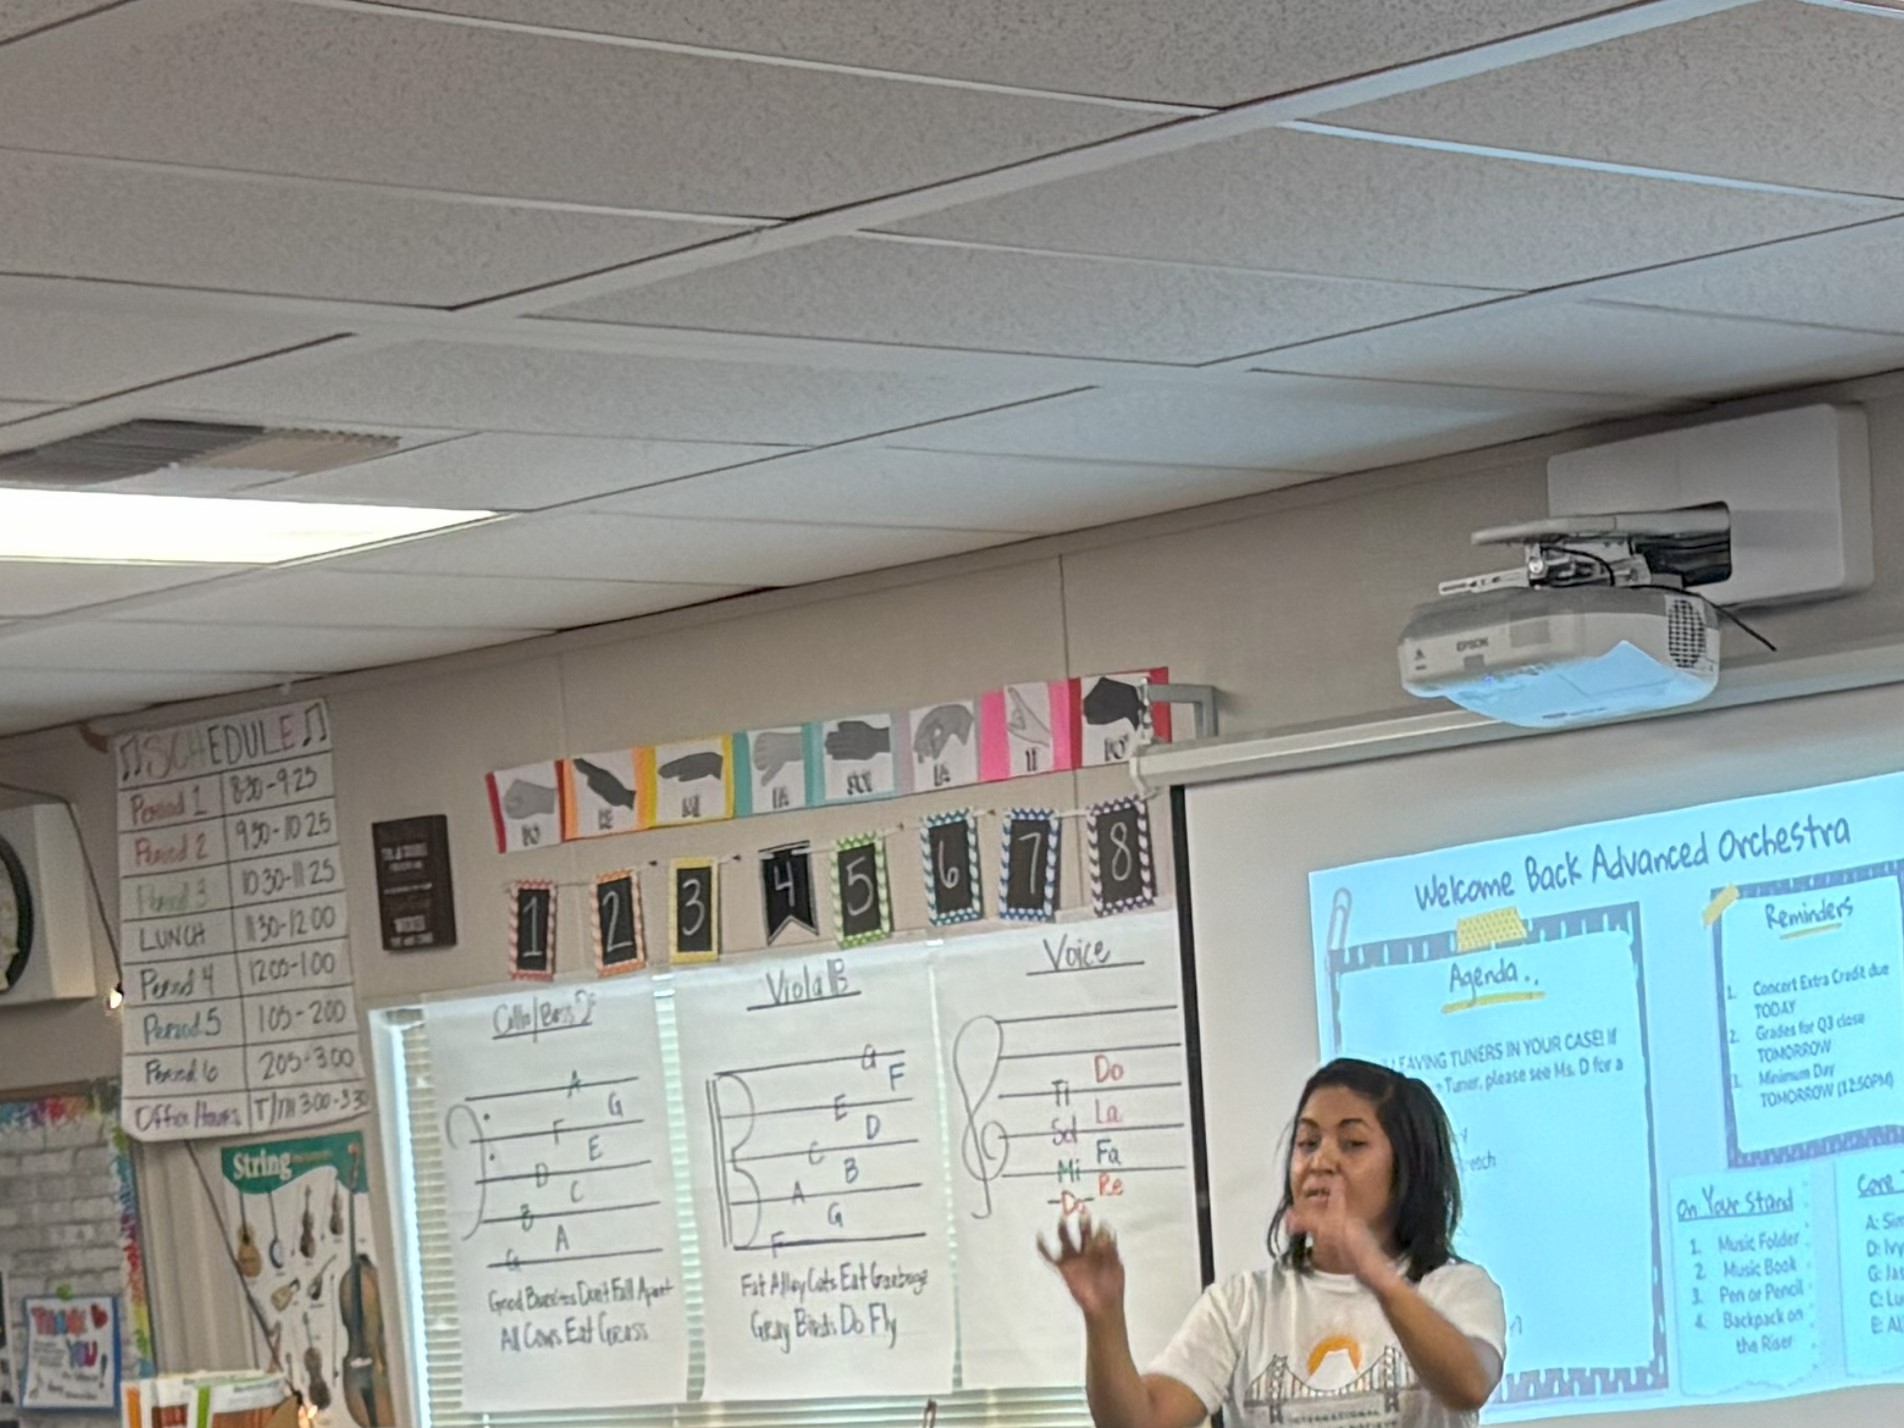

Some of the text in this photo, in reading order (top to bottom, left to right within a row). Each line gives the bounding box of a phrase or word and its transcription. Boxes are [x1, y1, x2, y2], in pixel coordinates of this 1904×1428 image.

[1018, 832, 1043, 898] 7
[1109, 819, 1133, 883] 8
[1414, 815, 1852, 913] Welcome Back Advanced Orchestra
[936, 843, 961, 892] 6
[773, 861, 797, 908] 4
[846, 862, 874, 916] 5
[681, 878, 705, 937] 3
[1764, 897, 1855, 932] Reminders
[522, 893, 543, 960] 1
[603, 892, 633, 954] 2
[1043, 933, 1110, 972] Voice
[767, 971, 823, 1005] Viola
[1753, 962, 1890, 997] Concert Extra Credit due
[206, 1007, 222, 1036] 5
[1754, 999, 1796, 1019] TODAY
[1798, 1013, 1865, 1034] for Q3 close
[1450, 1037, 1561, 1065] TUNERS IN YOUR
[1758, 1039, 1832, 1063] TOMORROW
[889, 1063, 905, 1092] F
[1094, 1054, 1124, 1083] Do
[1485, 1057, 1623, 1089] please see D for a
[1759, 1063, 1835, 1085] Minimum Day
[1760, 1083, 1834, 1108] TOMORROW
[865, 1115, 881, 1141] D
[232, 1150, 293, 1181] String
[1097, 1138, 1121, 1166] Fa
[1702, 1185, 1794, 1215] Your Stand
[1718, 1232, 1800, 1253] Music Folder
[1724, 1257, 1797, 1278] Music Book
[1720, 1280, 1804, 1302] Pen or Pencil
[840, 1301, 897, 1349] Do Fly
[1723, 1309, 1804, 1331] Backpack on
[1736, 1334, 1794, 1355] the Riser
